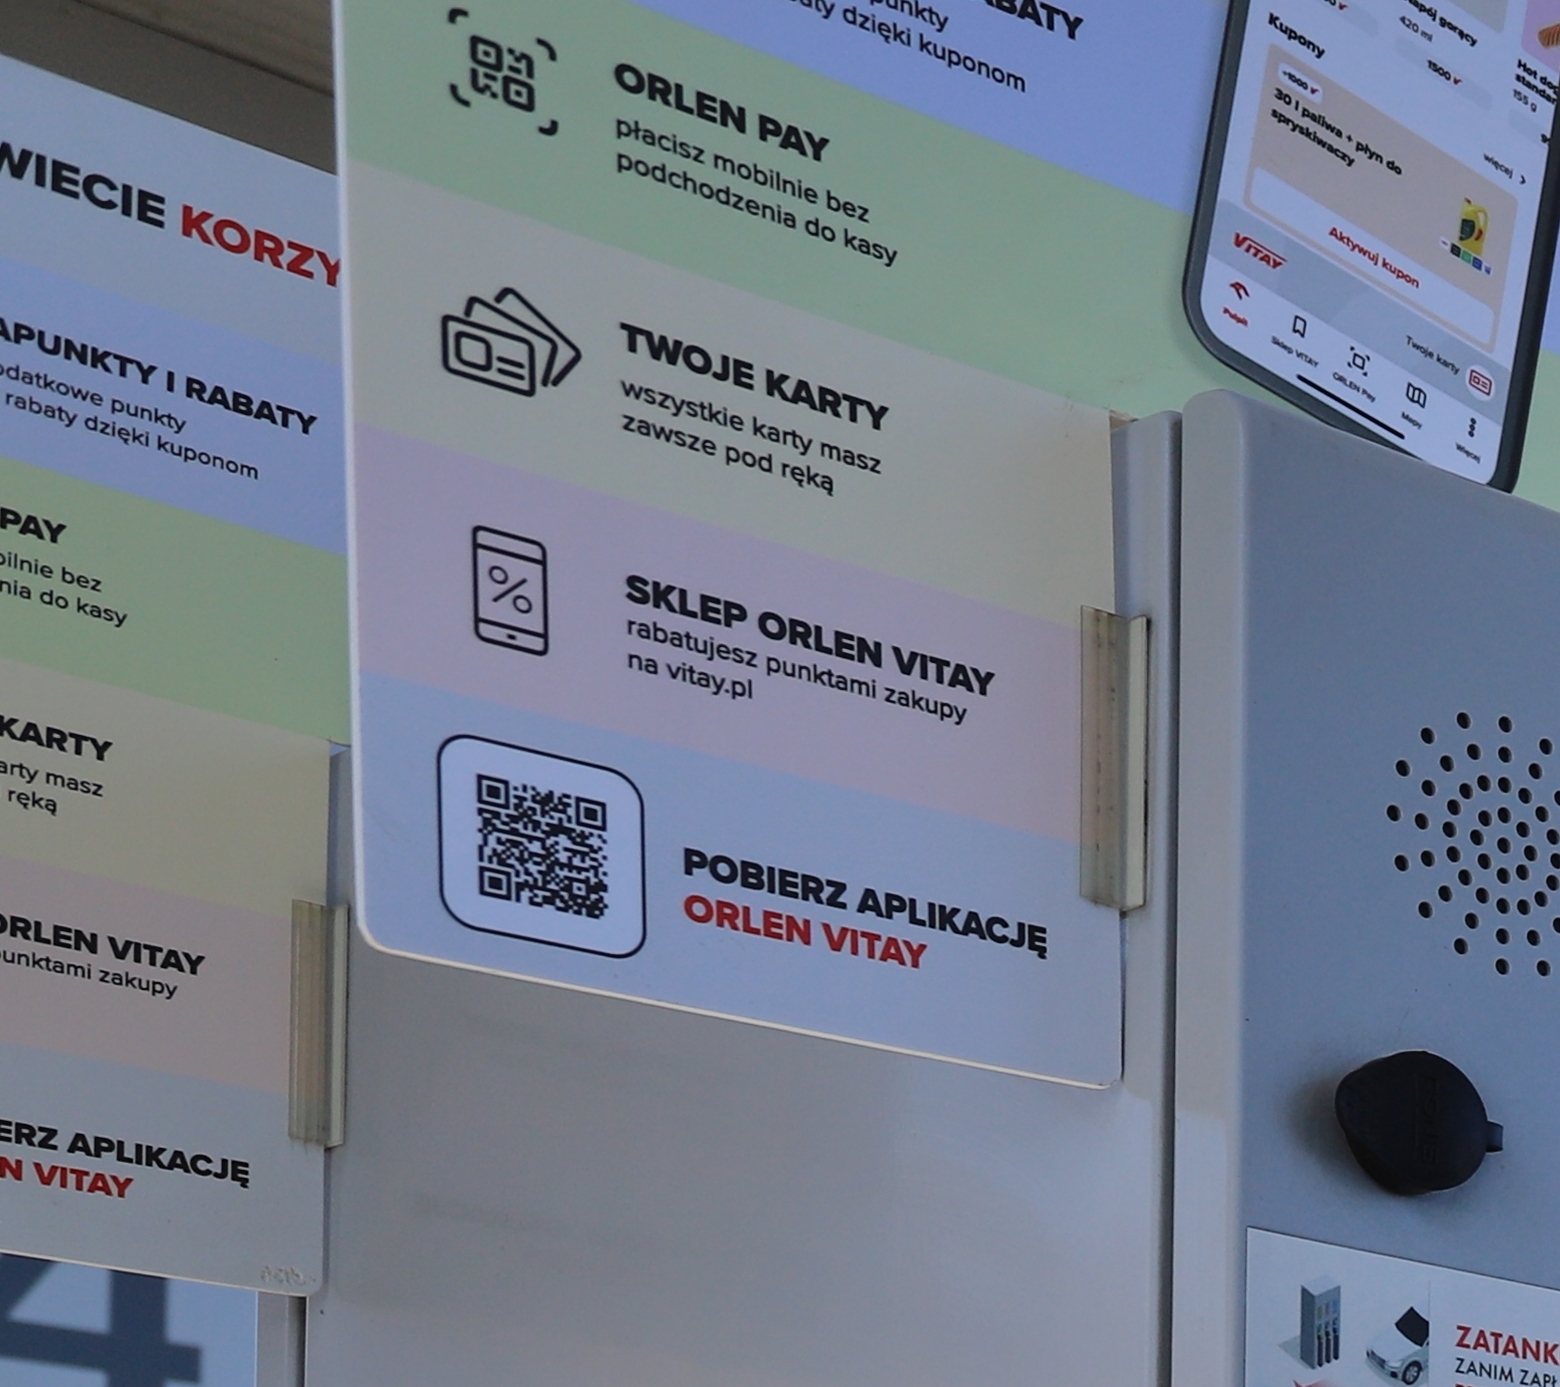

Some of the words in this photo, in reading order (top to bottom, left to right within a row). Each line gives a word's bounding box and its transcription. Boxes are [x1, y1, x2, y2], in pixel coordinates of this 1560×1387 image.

[842, 6, 911, 47] dzięki
[919, 33, 1025, 92] kuponom
[1268, 12, 1326, 59] Kupony
[1427, 59, 1451, 82] 1500
[615, 63, 746, 134] ORLEN
[759, 114, 829, 162] PAY
[1271, 108, 1356, 168] spryskiwaczy
[617, 119, 704, 164] płacisz
[714, 154, 818, 204] mobilnie
[827, 189, 869, 223] bez
[1484, 153, 1513, 180] więcej
[618, 153, 796, 229] podchodzenia
[805, 217, 835, 242] do
[844, 228, 897, 268] kasy
[1233, 232, 1286, 269] VITAY
[1328, 226, 1379, 266] Aktywuj
[1382, 257, 1420, 289] kupon
[620, 322, 753, 391] TWOJE
[766, 369, 889, 431] KARTY
[1406, 335, 1435, 362] Twoje
[1435, 352, 1460, 375] karty
[186, 377, 317, 435] RABATY
[621, 381, 743, 432] wszystkie
[753, 417, 812, 456] karty
[821, 442, 880, 474] masz
[623, 414, 716, 456] zawsze
[726, 446, 772, 473] pod
[782, 462, 833, 496] ręką
[0, 507, 66, 544] PAY
[626, 575, 747, 628] SKLEP
[758, 611, 882, 668] ORLEN
[892, 646, 995, 697] VITAY
[628, 620, 757, 668] rabatujesz
[767, 657, 875, 698] punktami
[885, 687, 967, 726] zakupy
[629, 654, 658, 675] na
[667, 662, 752, 700] vitay.pl
[684, 847, 847, 910] POBIERZ
[857, 888, 1047, 960] APLIKACJĘ
[685, 895, 810, 946] ORLEN
[822, 922, 927, 969] VITAY
[108, 936, 205, 976] VITAY
[67, 1132, 249, 1189] APLIKACJĘ
[1456, 1357, 1513, 1383] ZANIM
